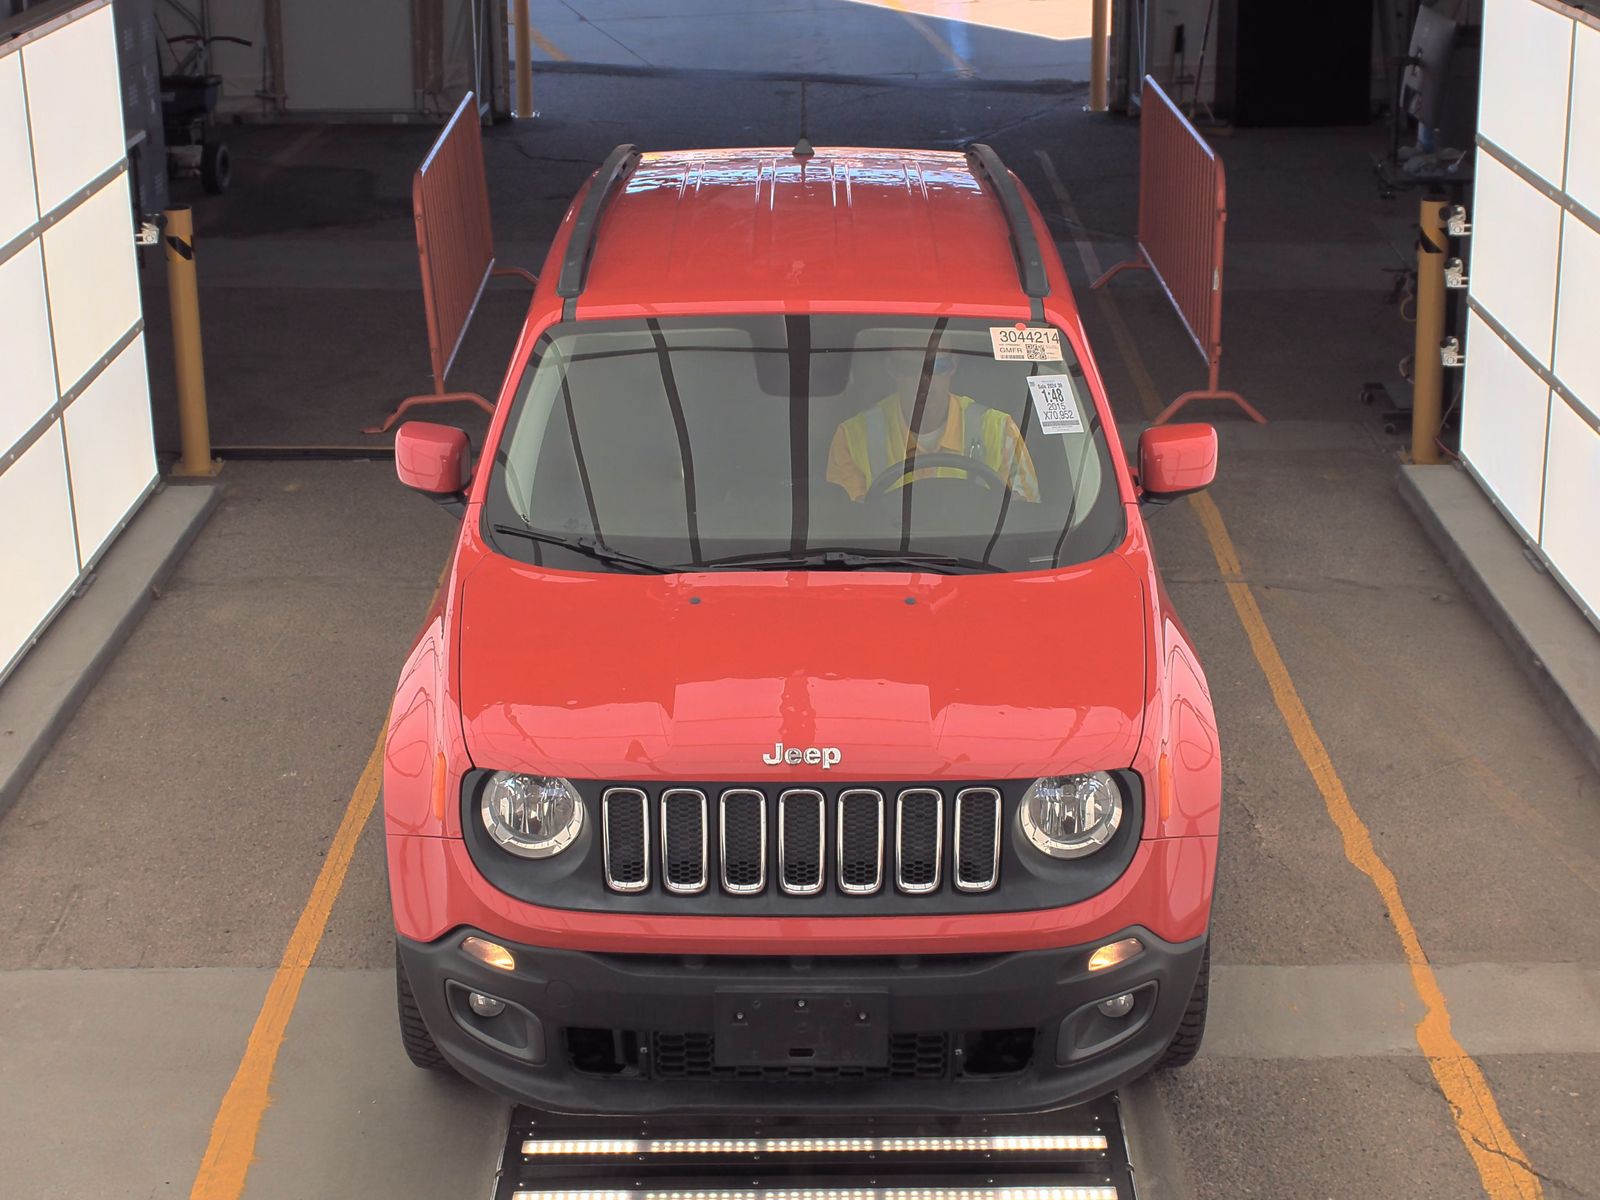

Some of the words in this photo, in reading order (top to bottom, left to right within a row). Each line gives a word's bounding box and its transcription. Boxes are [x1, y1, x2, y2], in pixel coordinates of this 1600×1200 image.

[999, 330, 1060, 344] 3044214
[1041, 388, 1064, 403] 1:48
[1047, 402, 1066, 411] 2015
[763, 742, 842, 769] Jeep
